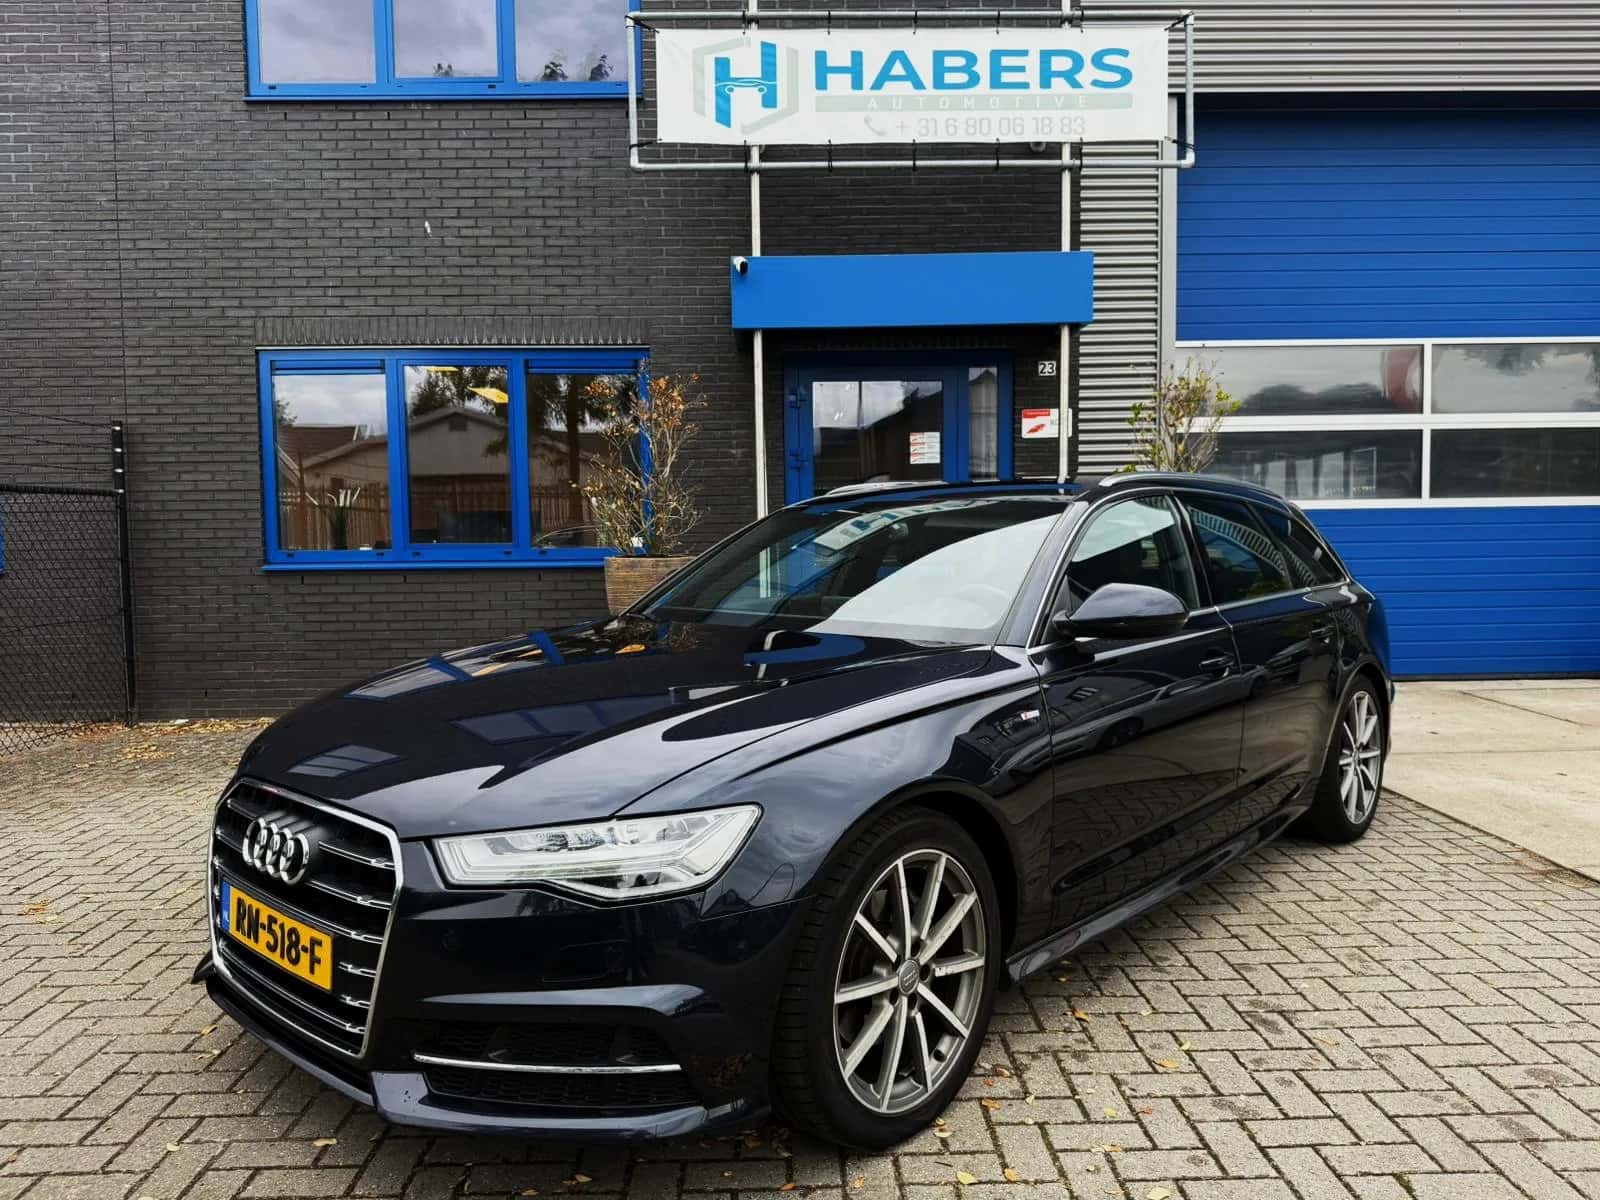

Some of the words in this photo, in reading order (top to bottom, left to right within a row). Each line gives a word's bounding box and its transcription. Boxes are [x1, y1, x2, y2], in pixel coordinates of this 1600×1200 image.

[814, 47, 1133, 91] HABERS
[867, 95, 1089, 112] AUTOMOTIVE
[917, 117, 939, 137] 31
[945, 117, 958, 137] 6
[965, 117, 992, 136] 80
[999, 116, 1025, 136] 06
[1032, 116, 1053, 135] 18
[1060, 115, 1087, 135] 83
[1039, 362, 1055, 375] 23
[235, 896, 323, 976] RN-518-F
